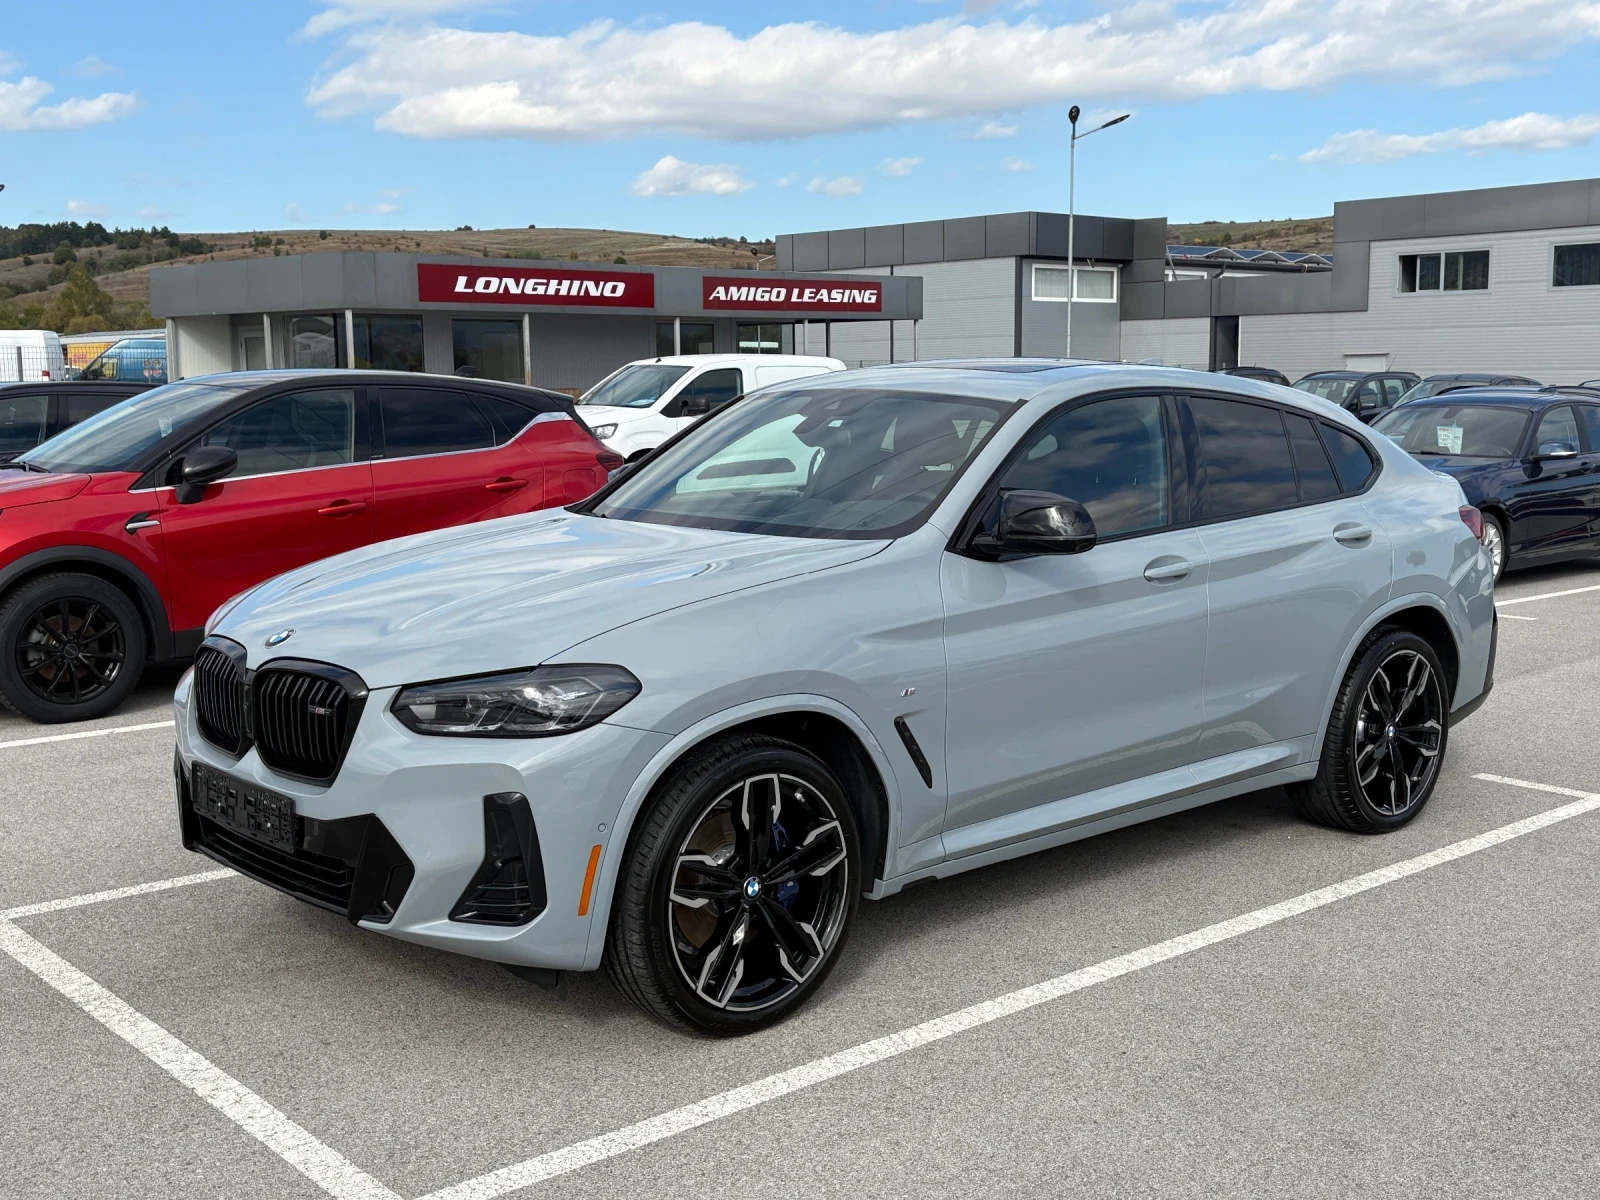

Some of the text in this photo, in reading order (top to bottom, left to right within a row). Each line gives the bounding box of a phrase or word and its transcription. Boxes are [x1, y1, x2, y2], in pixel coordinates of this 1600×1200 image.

[454, 275, 626, 298] LONGHINO
[708, 286, 878, 304] AMIGO LEASING
